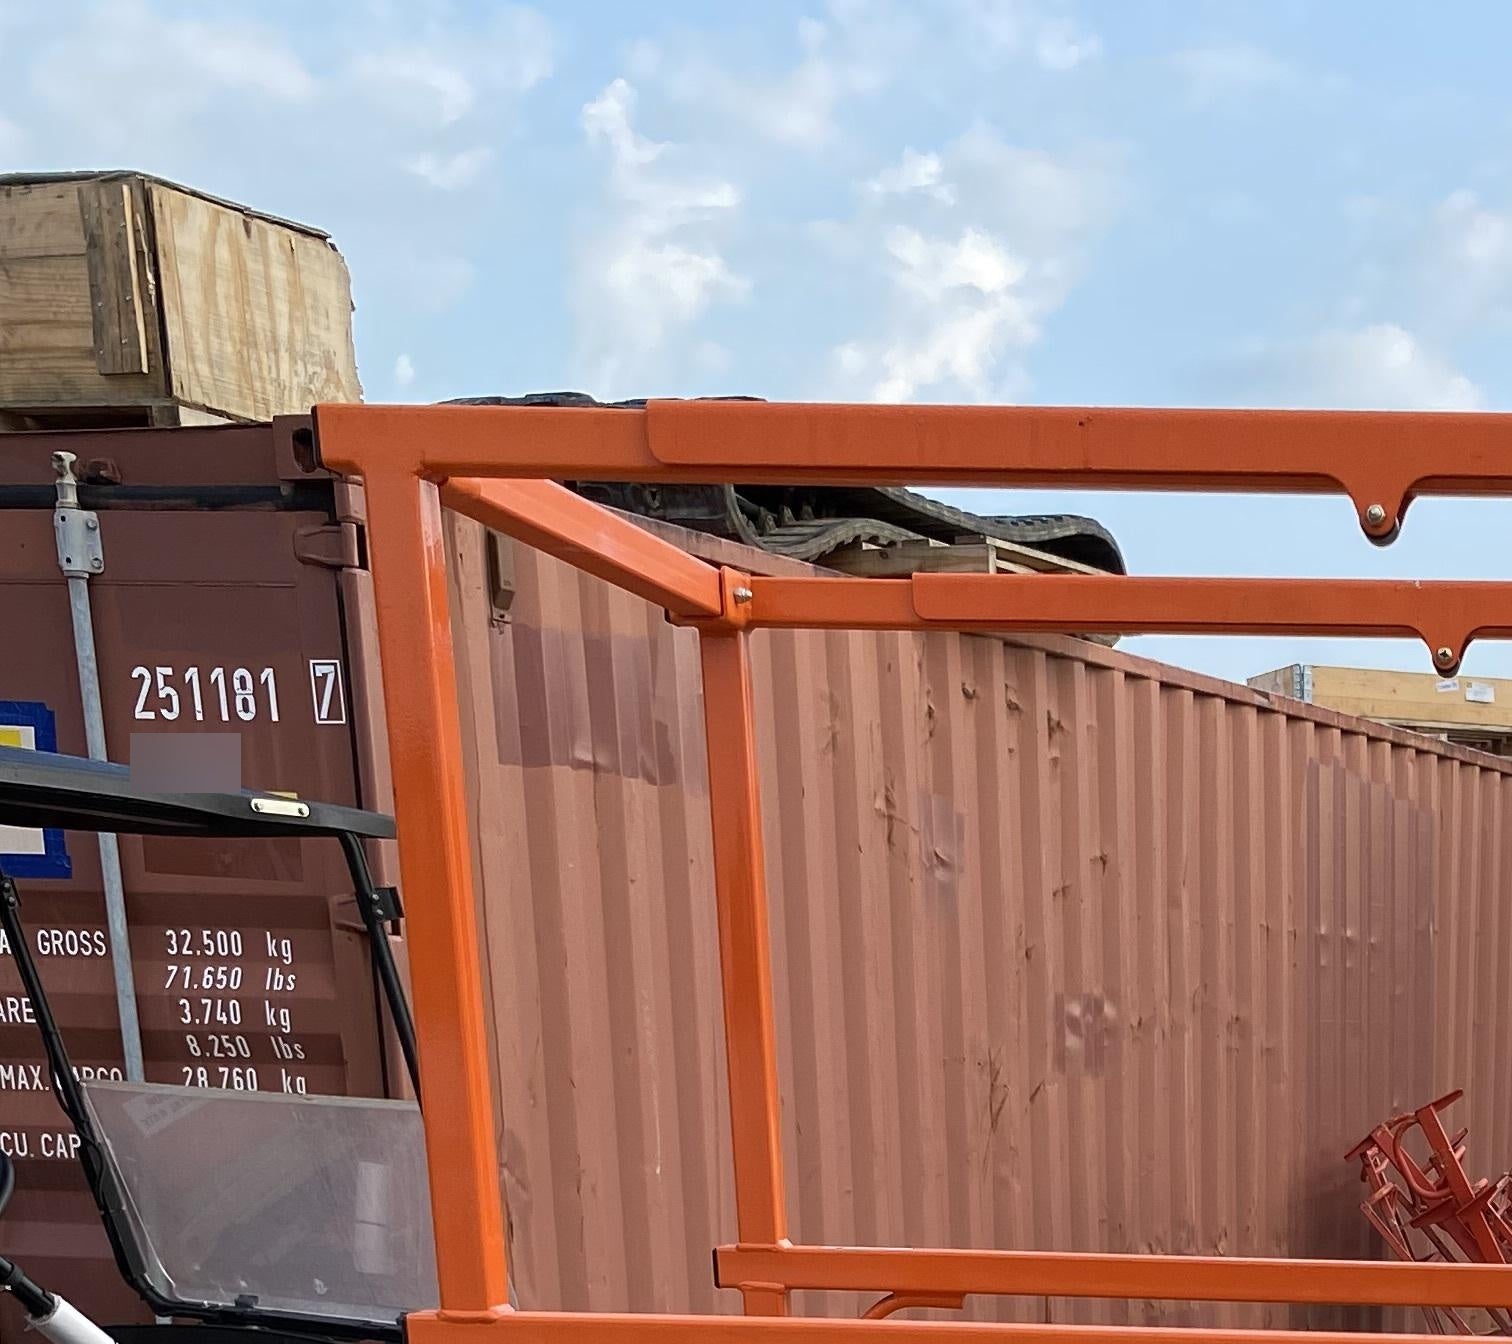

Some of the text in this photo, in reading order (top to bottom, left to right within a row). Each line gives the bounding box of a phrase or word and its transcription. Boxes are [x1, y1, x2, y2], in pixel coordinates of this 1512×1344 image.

[131, 666, 337, 722] 251181 7
[37, 929, 107, 956] GROSS
[165, 930, 293, 964] 32.500 kg
[165, 965, 297, 991] 71.650 lbs
[179, 1000, 291, 1033] 3.740 kg
[186, 1034, 306, 1060] 8.250 lbs
[1, 1064, 50, 1091] MAX.
[182, 1067, 306, 1094] 28760 kg
[0, 1132, 35, 1158] CU.
